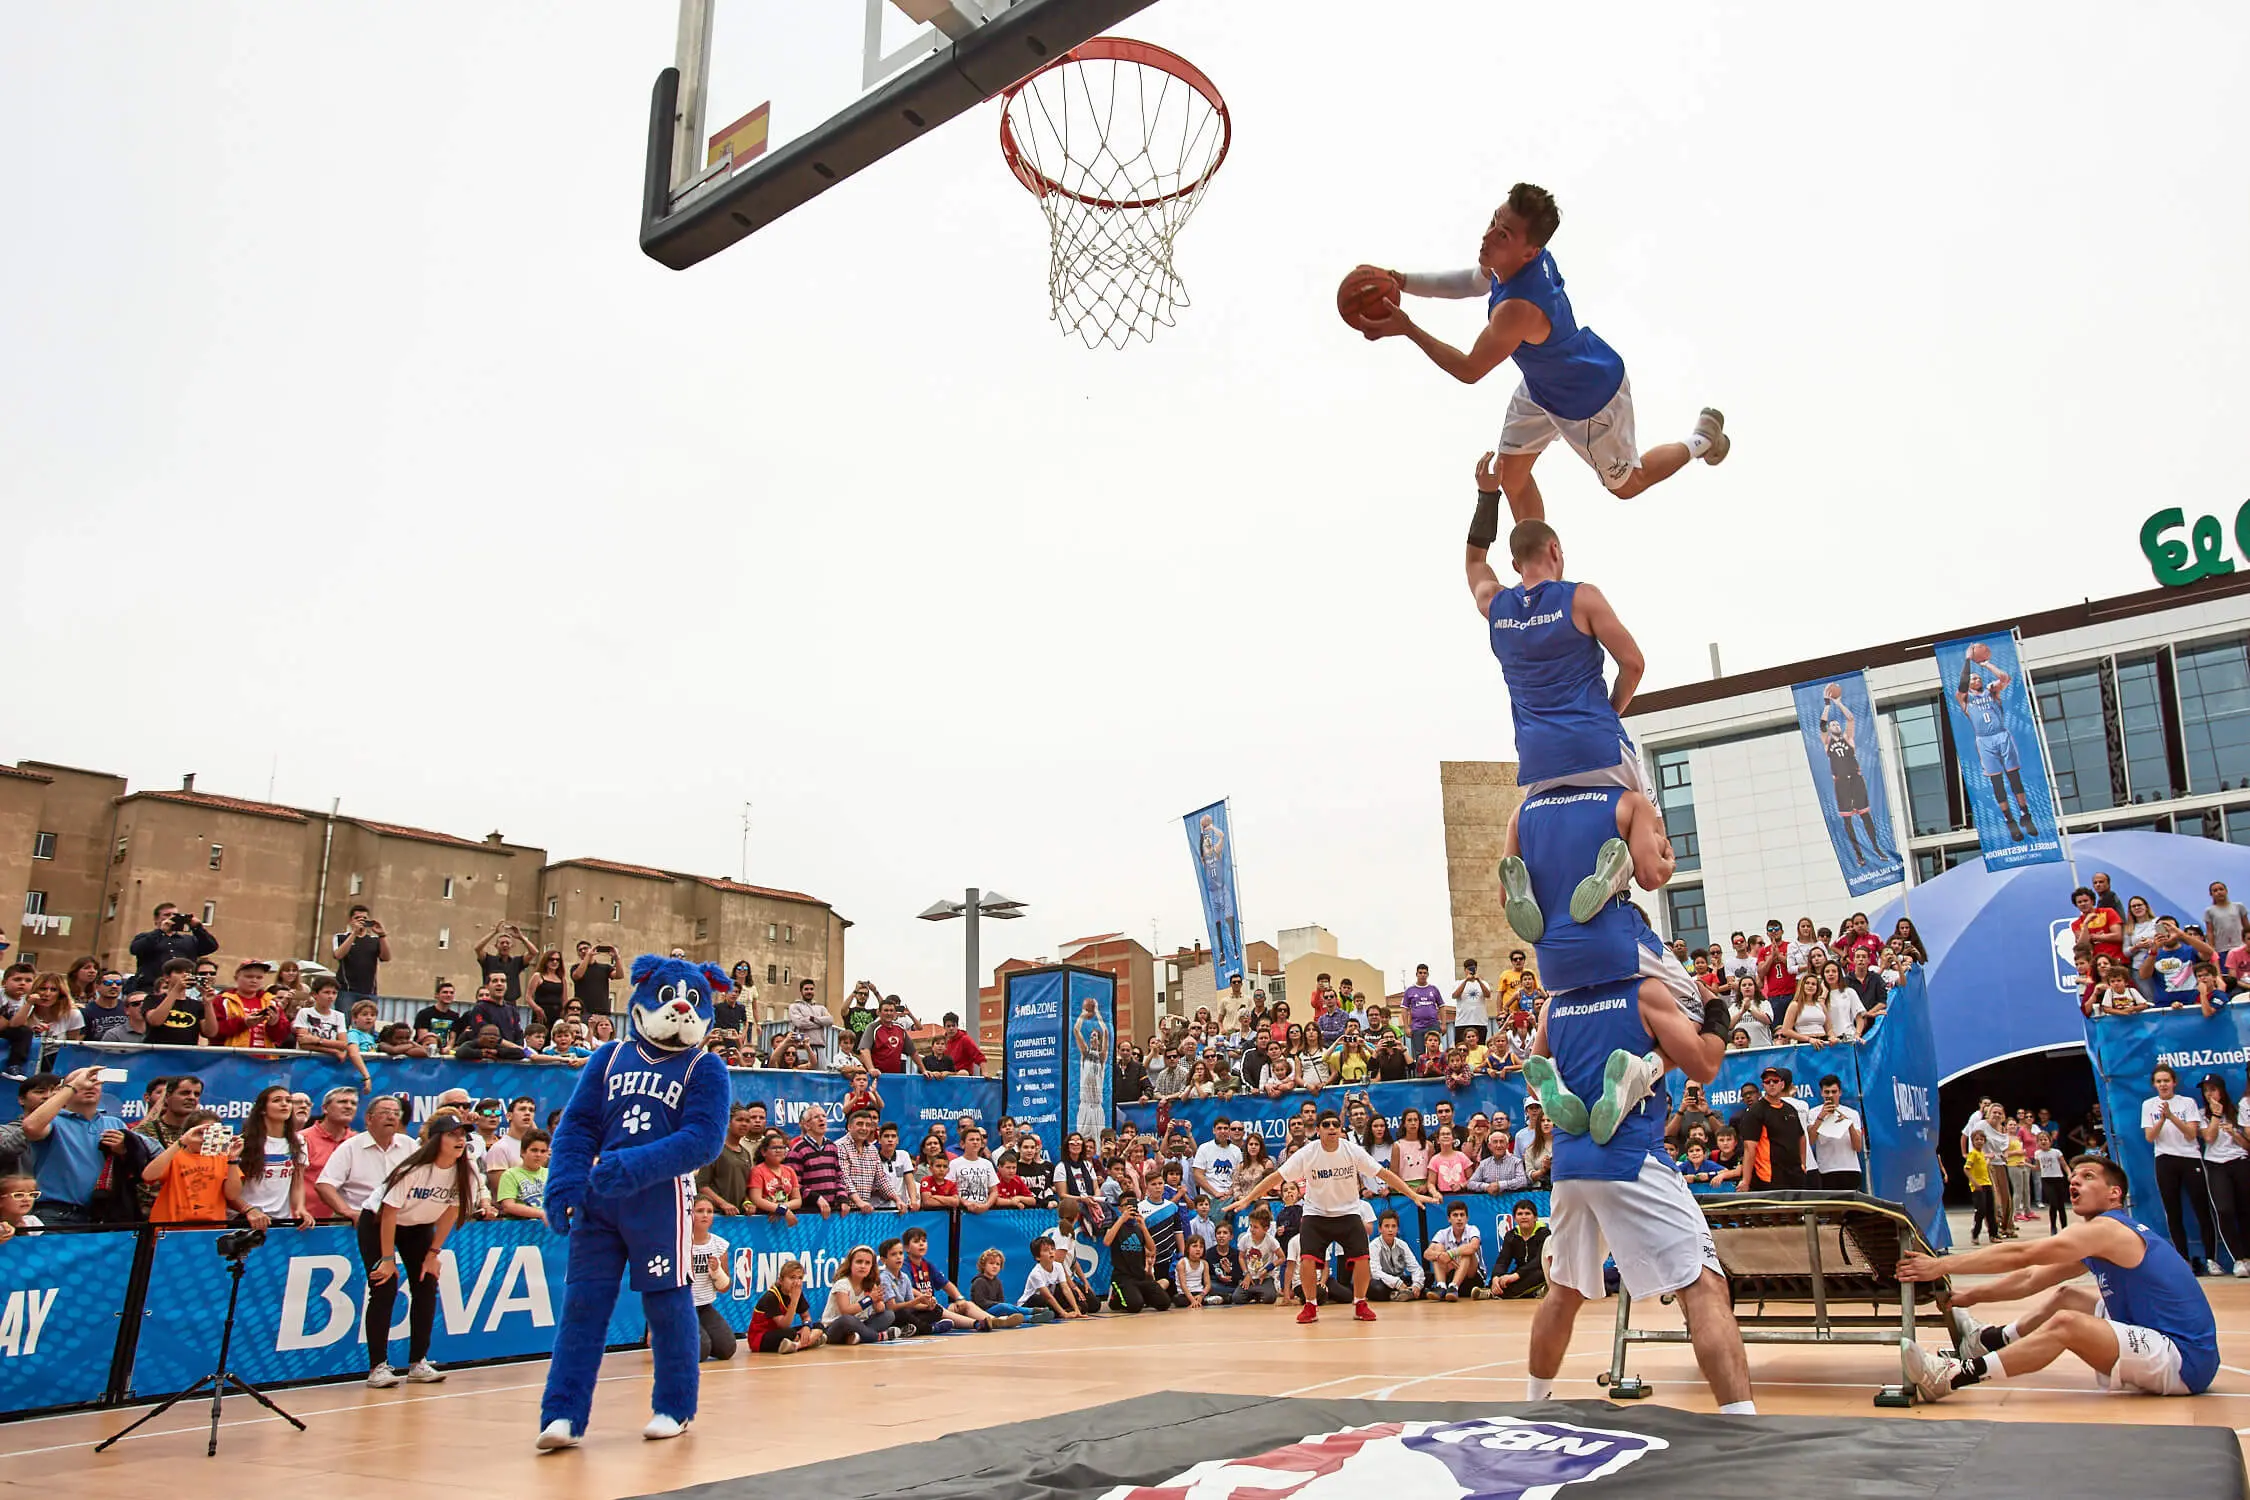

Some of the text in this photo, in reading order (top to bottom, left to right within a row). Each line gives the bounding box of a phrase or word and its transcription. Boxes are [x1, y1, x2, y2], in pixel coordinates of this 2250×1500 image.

[1775, 963, 1783, 979] 1
[1048, 1035, 1056, 1045] TU
[1015, 1048, 1056, 1059] EXPERIENCIA!
[607, 1071, 684, 1110] PHILA
